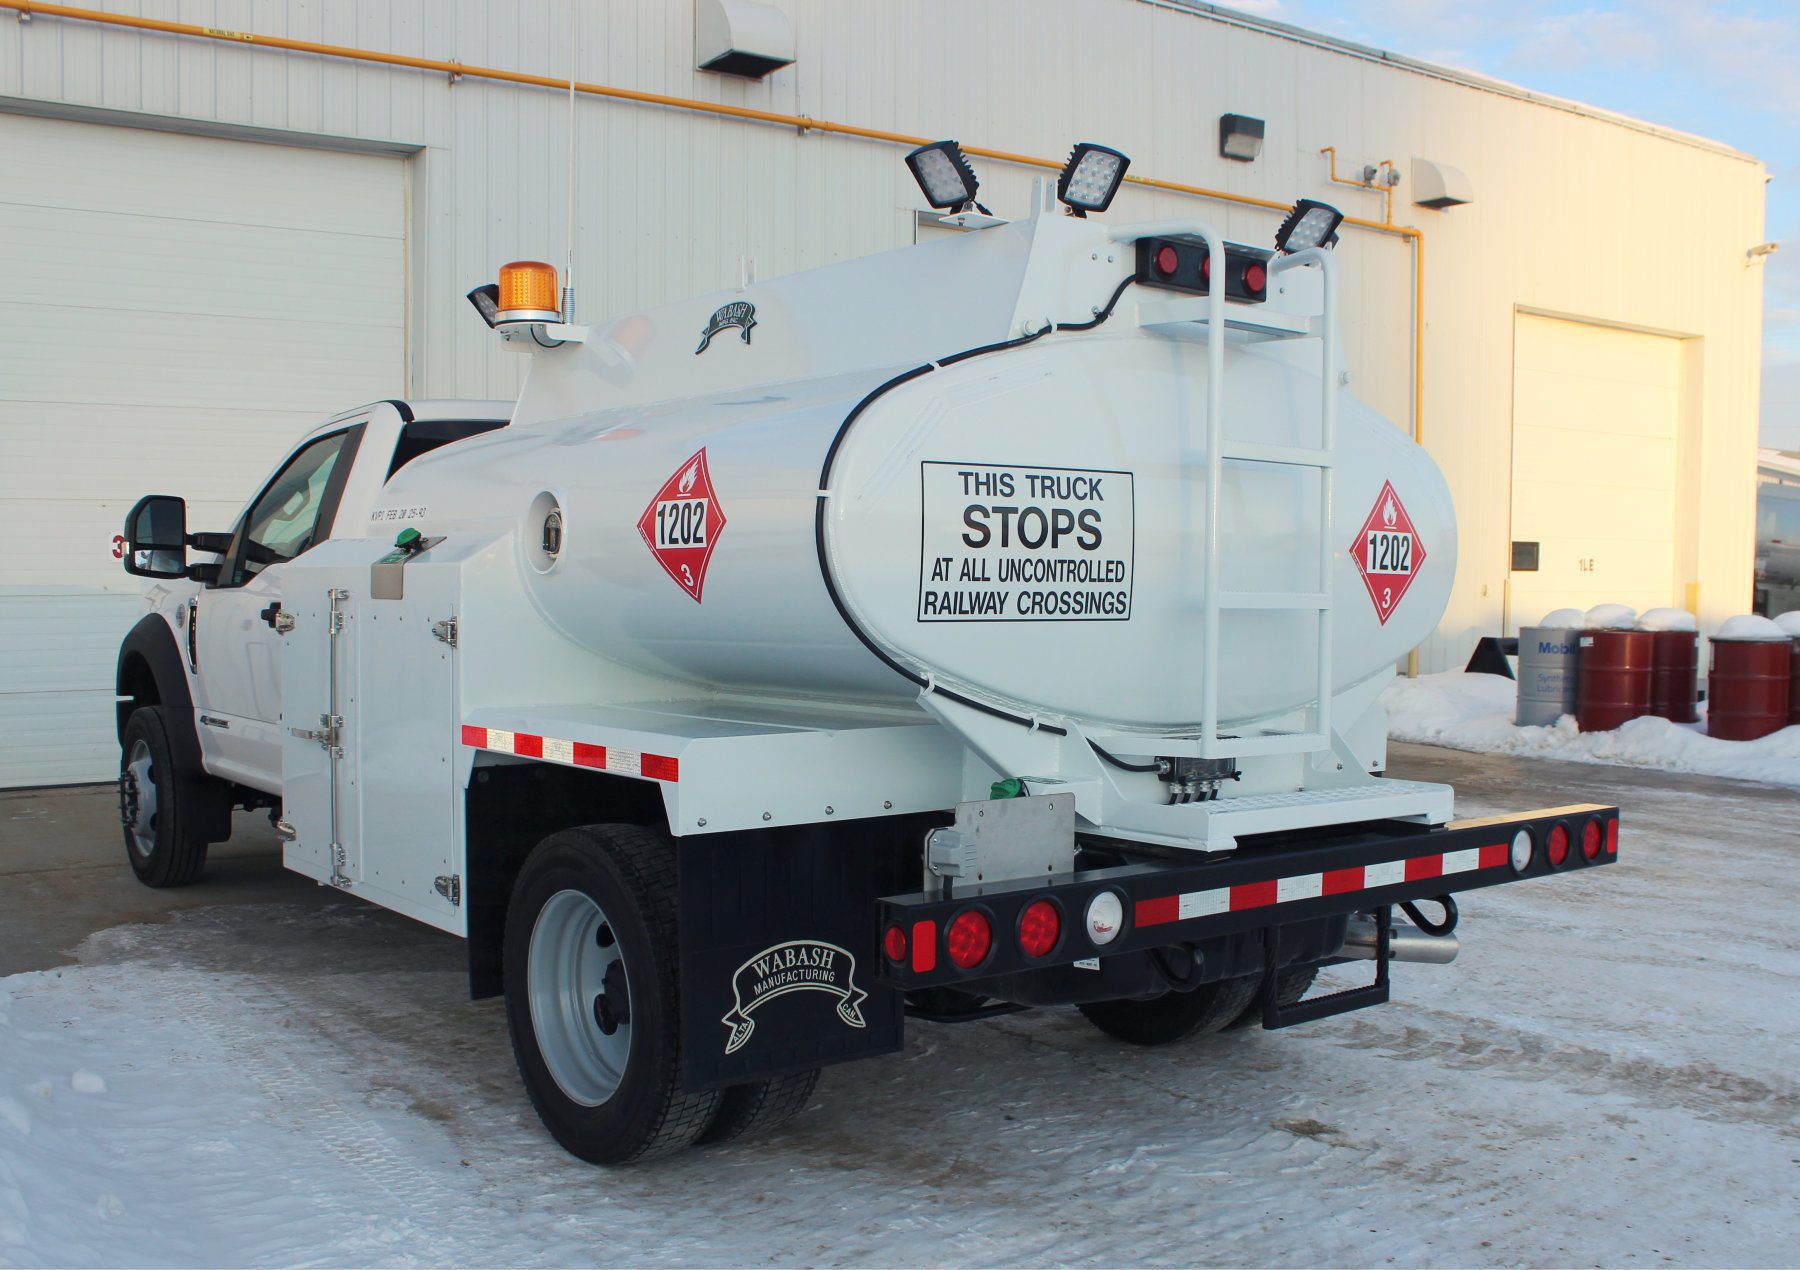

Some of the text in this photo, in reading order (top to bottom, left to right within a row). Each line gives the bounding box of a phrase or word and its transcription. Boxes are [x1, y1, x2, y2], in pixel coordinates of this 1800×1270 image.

[716, 303, 748, 322] WABASH
[958, 472, 1104, 501] THIS TRUCK
[657, 502, 704, 545] 1202
[962, 504, 1103, 550] STOPS
[112, 534, 125, 559] 3
[1369, 533, 1410, 572] 1202
[681, 564, 694, 587] 3
[931, 557, 1125, 583] AT ALL UNCONTROLLED
[924, 591, 1127, 615] RAILWAY CROSSINGS
[1382, 587, 1392, 608] 3
[1538, 642, 1576, 655] Mobil
[752, 947, 836, 979] WABASH
[753, 969, 836, 996] MANUFACTURING
[842, 1003, 857, 1020] CAN.
[732, 1020, 750, 1044] ALTA.
